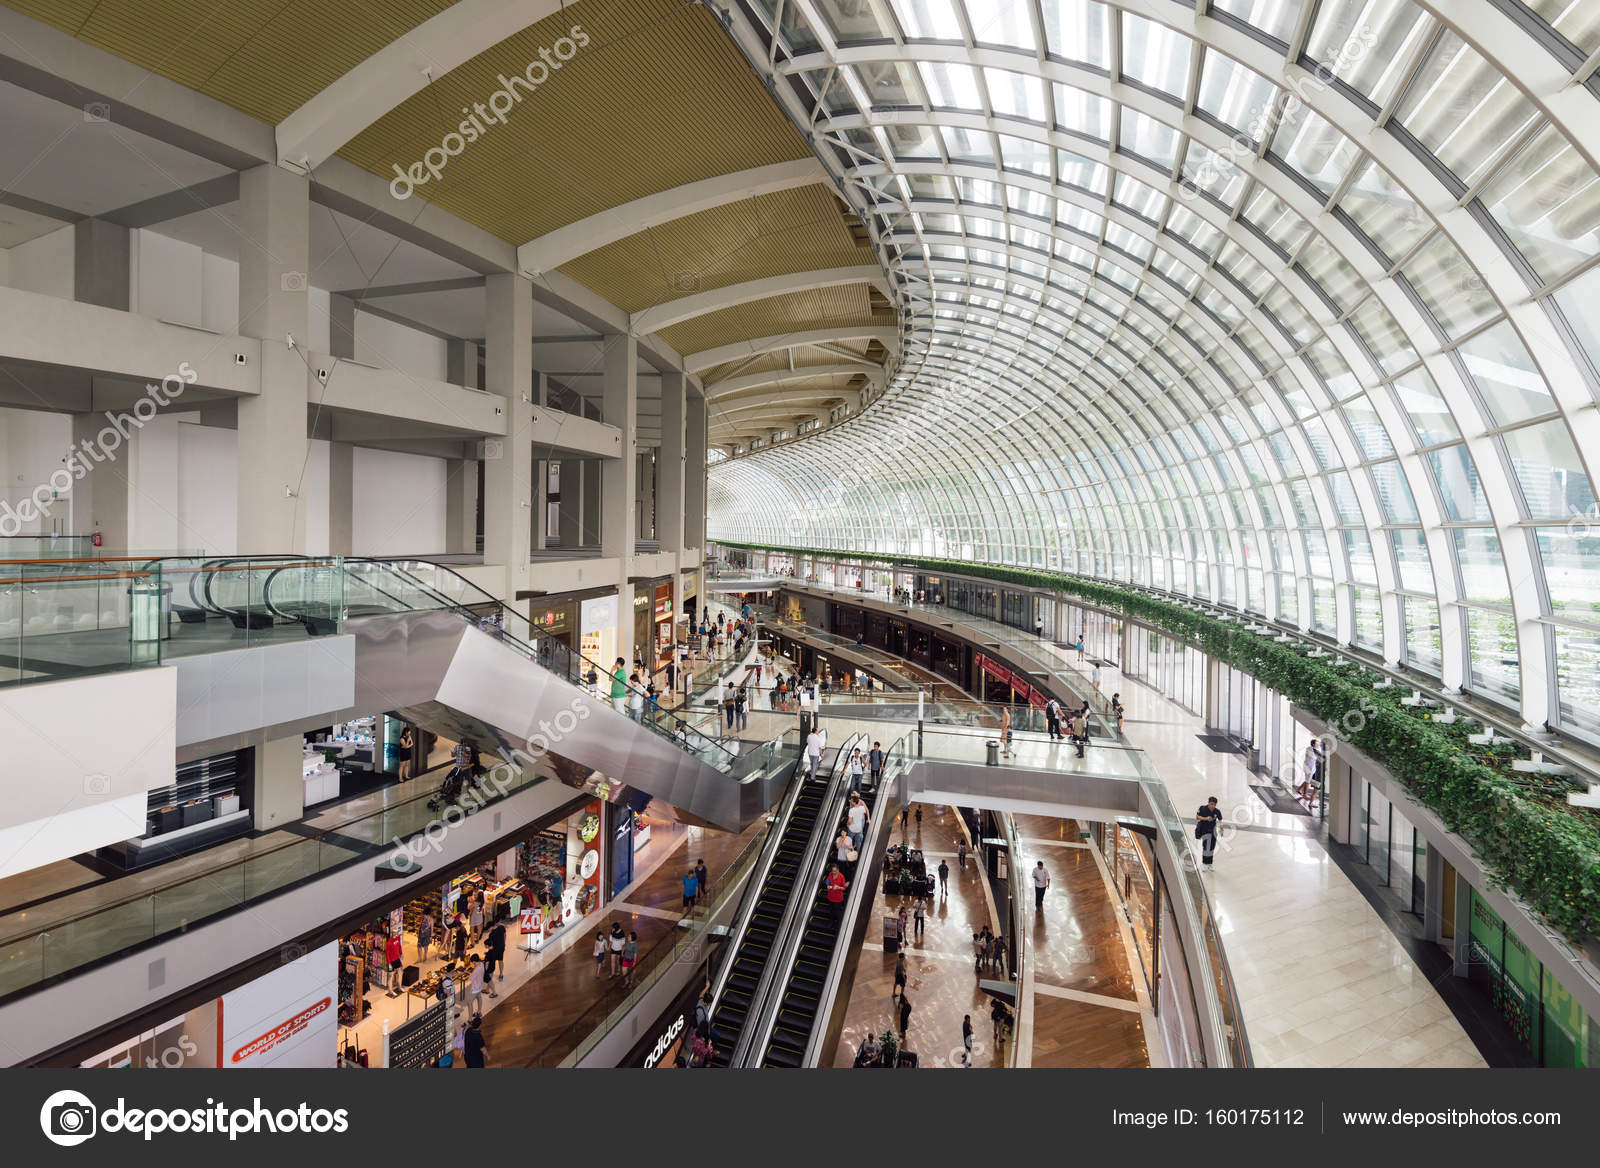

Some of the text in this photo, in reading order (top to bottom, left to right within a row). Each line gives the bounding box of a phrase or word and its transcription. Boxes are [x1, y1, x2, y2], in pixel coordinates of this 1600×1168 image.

[239, 1002, 326, 1058] WORLD OF SPORTS
[644, 1014, 684, 1068] adidas
